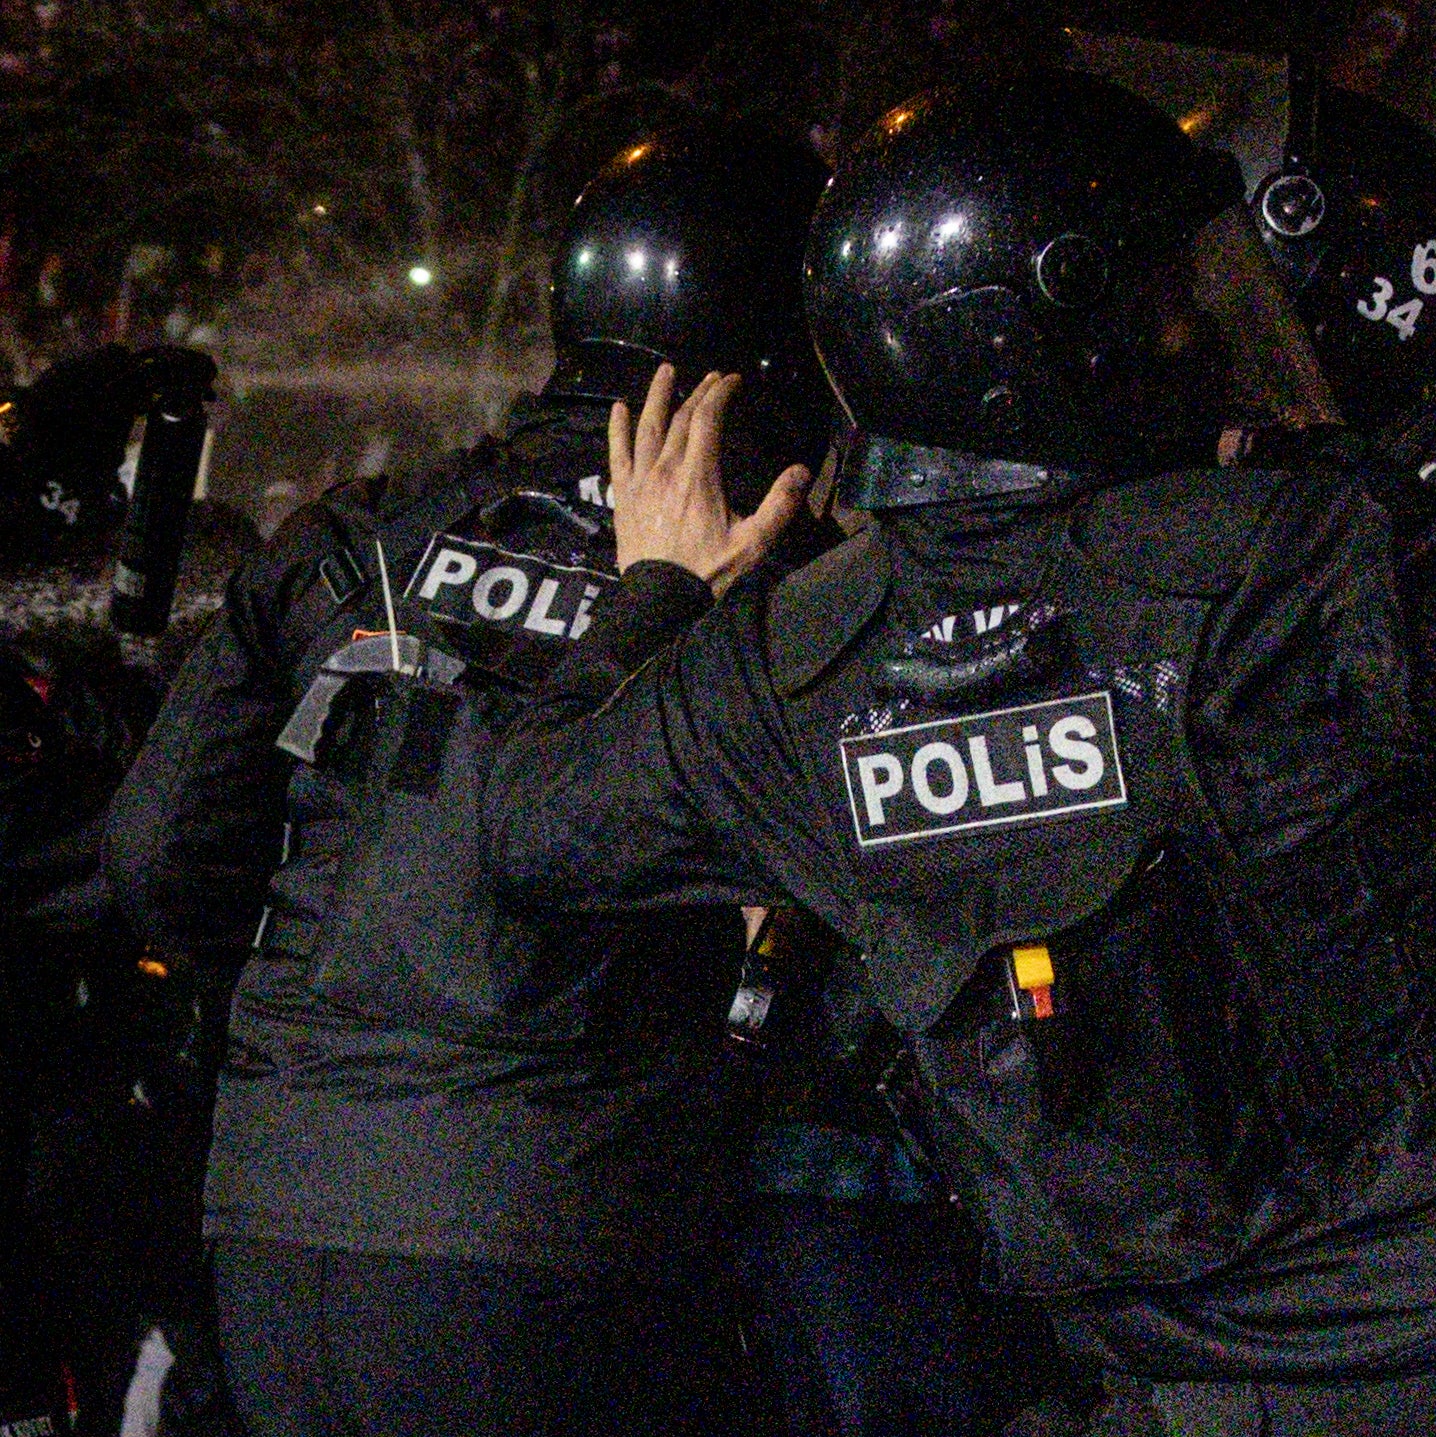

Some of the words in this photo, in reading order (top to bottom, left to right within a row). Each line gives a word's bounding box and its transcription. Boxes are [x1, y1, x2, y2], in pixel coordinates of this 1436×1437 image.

[1355, 275, 1425, 342] 34
[38, 479, 82, 526] 34
[419, 547, 602, 641] POLi
[856, 714, 1105, 827] POLiS
